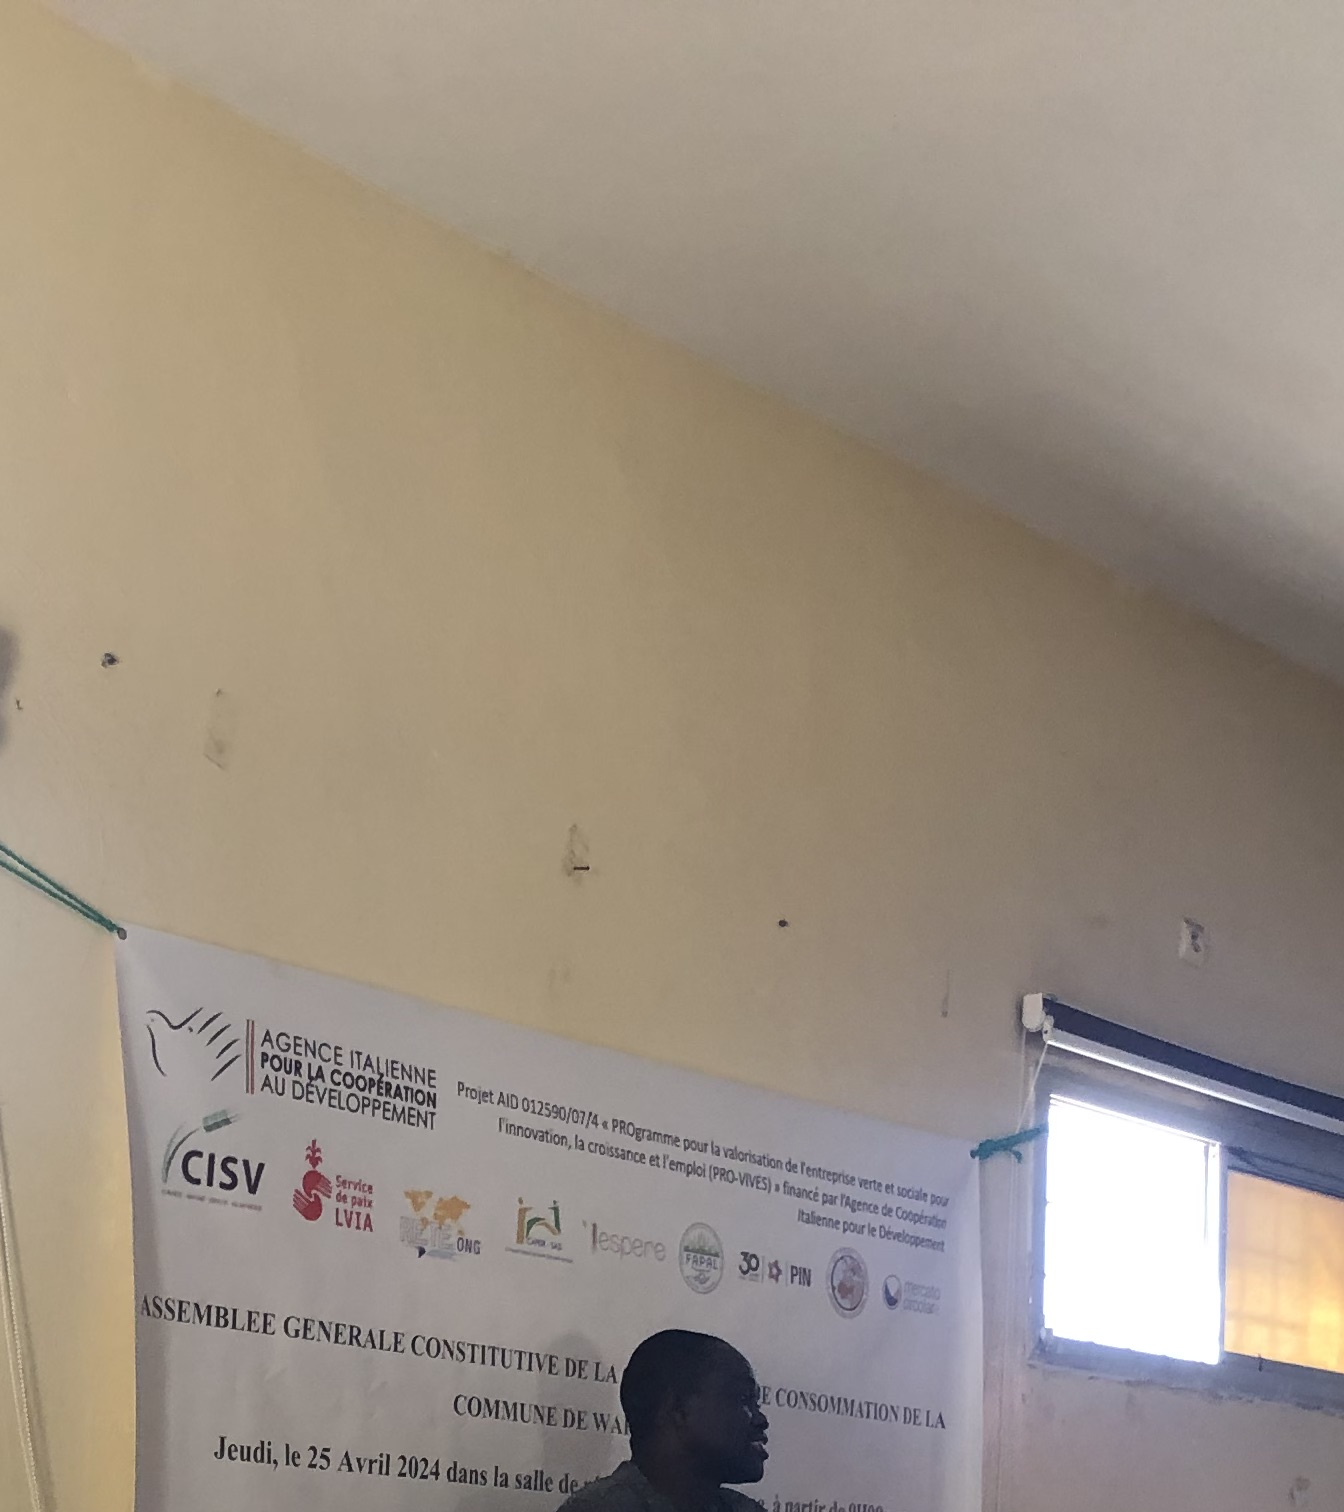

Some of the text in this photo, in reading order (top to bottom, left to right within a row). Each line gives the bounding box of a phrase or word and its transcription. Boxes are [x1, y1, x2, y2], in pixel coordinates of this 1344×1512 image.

[260, 1052, 437, 1109] POUR LA COOPÉRATION
[261, 1029, 437, 1088] AGENCE ITALIENNE
[260, 1074, 436, 1130] AU DÉVELOPPEMENT
[457, 1081, 494, 1105] Projet
[497, 1092, 519, 1110] AID
[522, 1097, 599, 1129] 012590/07/4
[612, 1119, 681, 1148] PROgramme
[683, 1138, 709, 1155] pour
[711, 1140, 721, 1157] la
[723, 1145, 783, 1170] valorisation
[785, 1157, 798, 1174] de
[801, 1161, 856, 1187] l'entreprise
[858, 1177, 882, 1193] verte
[885, 1182, 894, 1195] et
[897, 1184, 928, 1203] sociale
[931, 1193, 949, 1208] pour
[181, 1150, 265, 1195] CISV
[336, 1175, 373, 1194] Service
[498, 1117, 571, 1150] l'innovation,
[574, 1134, 585, 1151] la
[588, 1141, 646, 1165] croissance
[649, 1153, 661, 1169] et
[663, 1154, 706, 1178] l'emploi
[709, 1164, 772, 1194] (PRO-VIVES)
[783, 1181, 819, 1202] financé
[822, 1193, 838, 1207] par
[840, 1193, 879, 1214] l'Agence
[881, 1203, 893, 1217] de
[336, 1190, 373, 1208] de paix
[336, 1208, 373, 1232] LVIA
[457, 1237, 481, 1255] ONG
[798, 1209, 945, 1252] Italienne pour le Développement
[739, 1251, 812, 1287] 30 PIN
[140, 1295, 618, 1384] ASSEMBLEE GENERALE CONSTITUTIVE DE LA
[453, 1394, 557, 1426] COMMUNE
[562, 1408, 587, 1431] DE
[775, 1387, 899, 1423] CONSOMMATION
[903, 1407, 922, 1427] DE
[925, 1410, 946, 1429] LA
[214, 1436, 278, 1471] Jeudi,
[285, 1443, 301, 1467] le
[307, 1445, 331, 1471] 25
[338, 1450, 391, 1477] Avril
[397, 1455, 440, 1481] 2024
[447, 1461, 488, 1486] dans
[494, 1466, 509, 1488] la
[515, 1470, 554, 1493] salle
[558, 1473, 579, 1494] de
